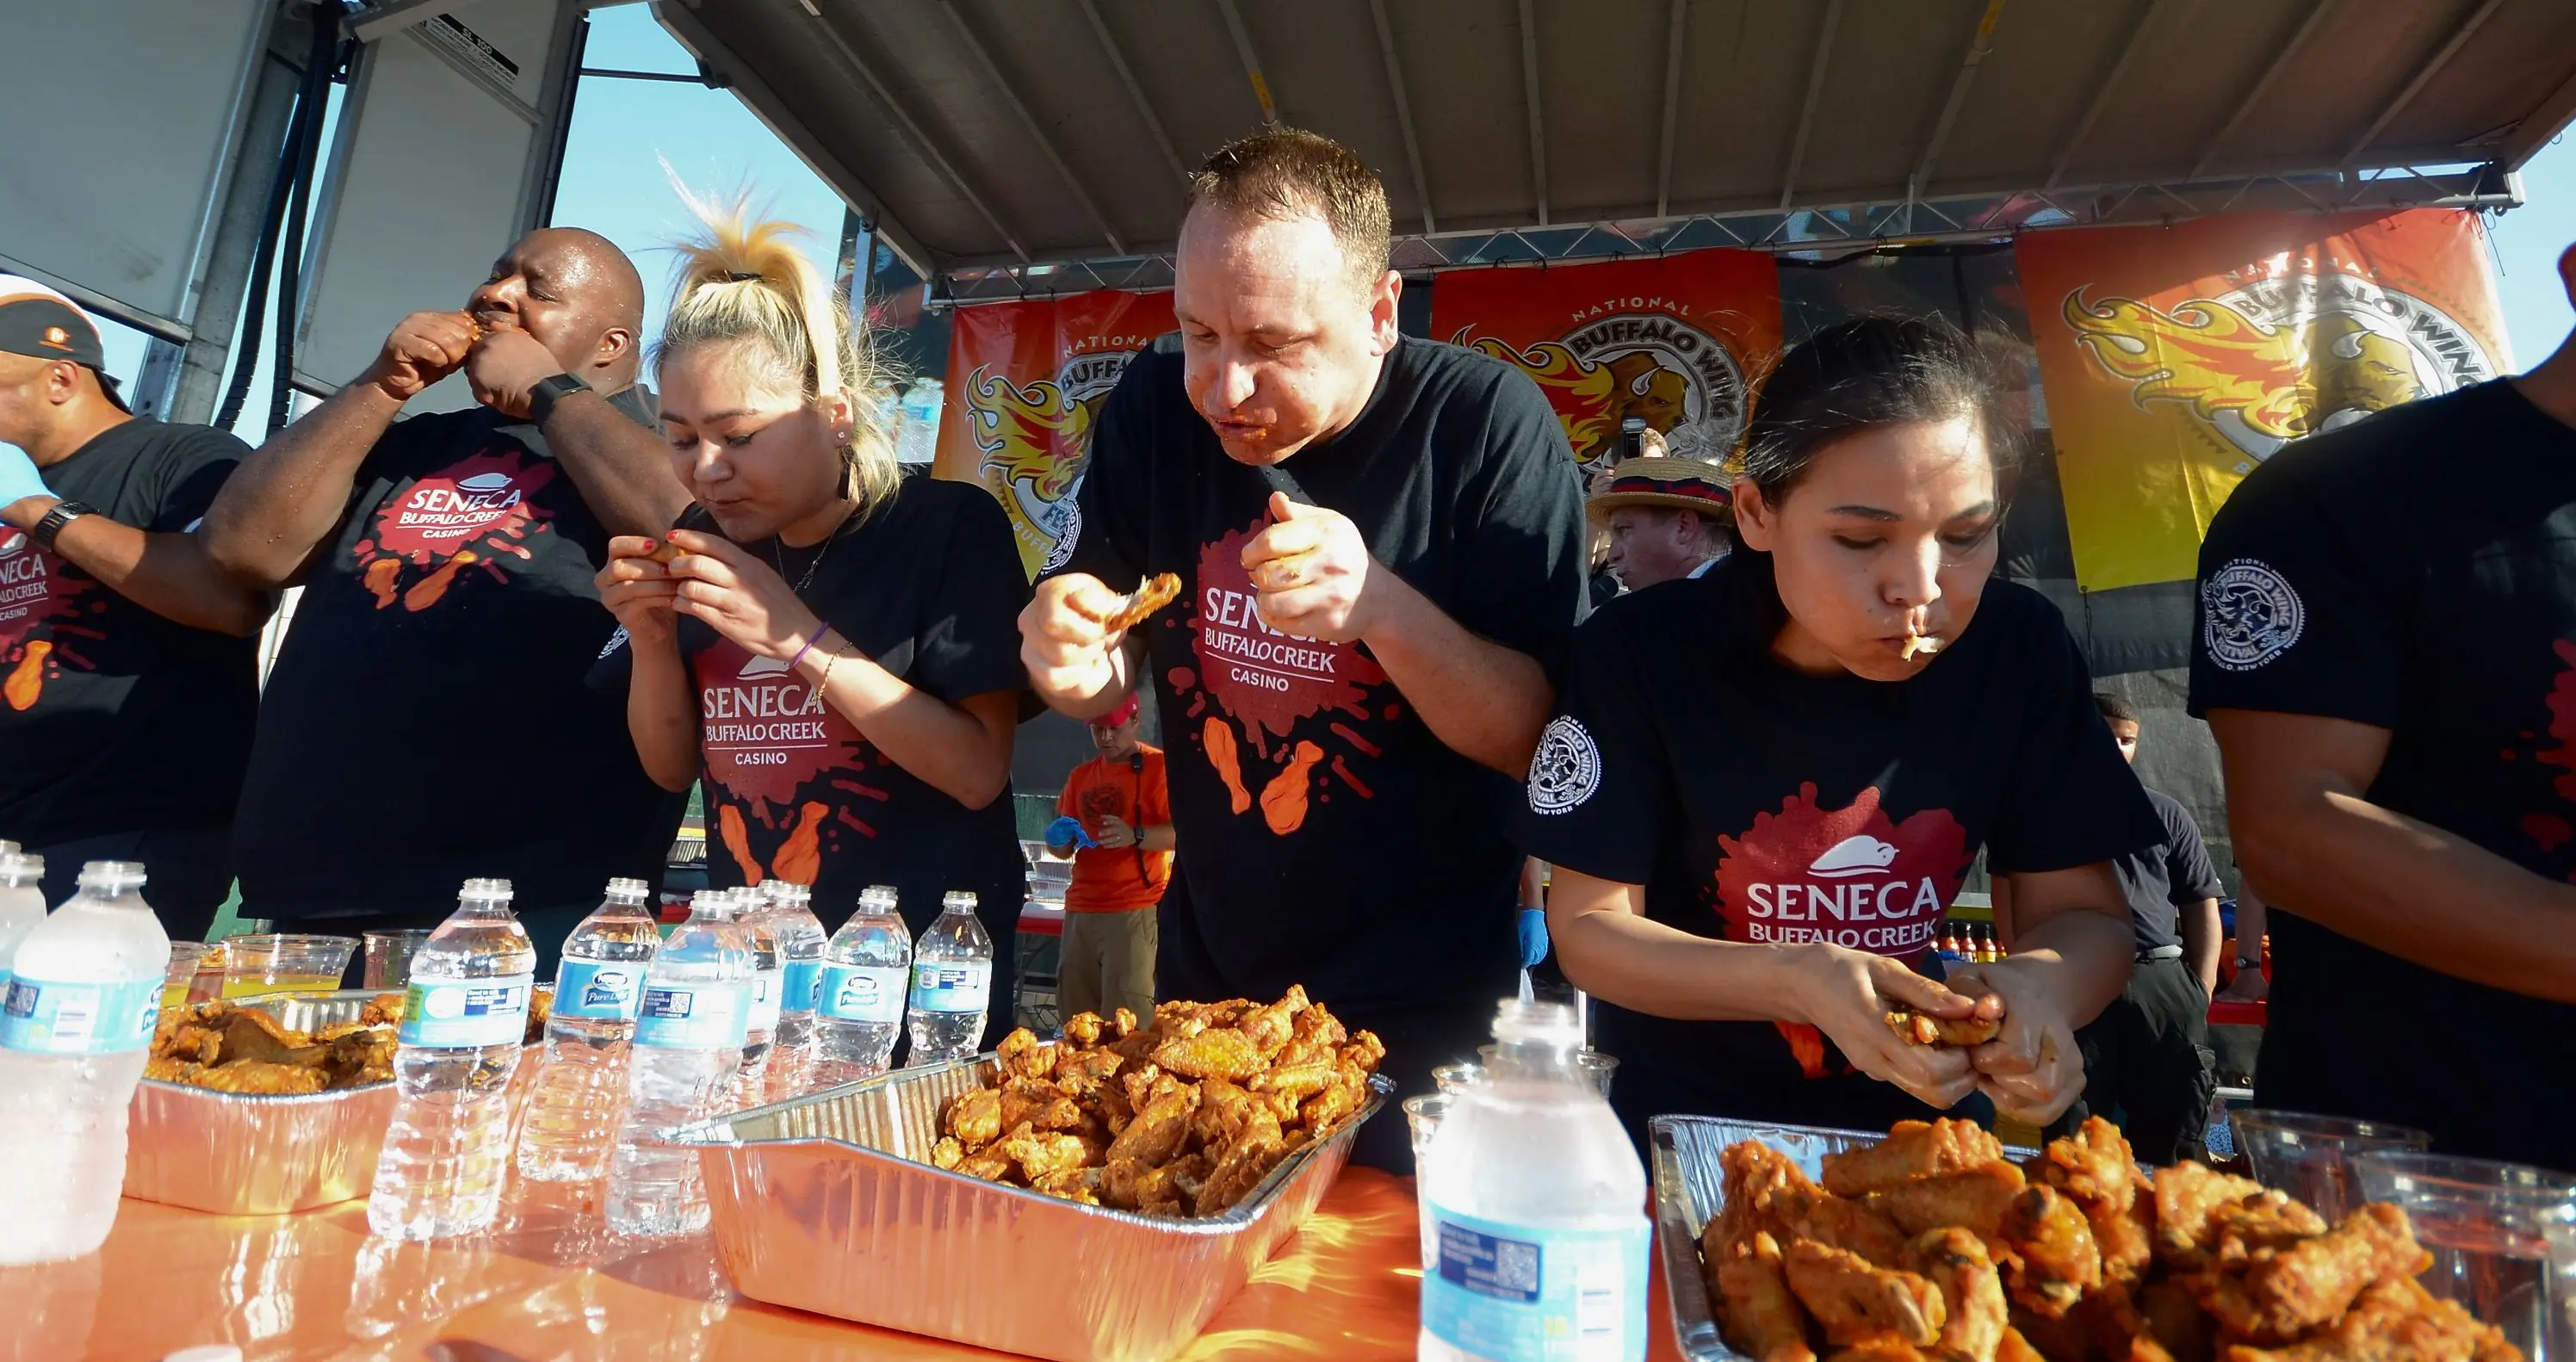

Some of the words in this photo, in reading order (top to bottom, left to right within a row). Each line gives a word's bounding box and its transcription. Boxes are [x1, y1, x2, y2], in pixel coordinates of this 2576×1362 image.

[461, 28, 474, 41] SL
[476, 38, 493, 54] 100
[1572, 296, 1690, 323] NATIONAL
[1063, 335, 1148, 358] NATIONA
[1574, 319, 1700, 358] BUFFALO
[1693, 344, 1738, 421] WING
[406, 489, 521, 512] SENECA
[399, 511, 463, 525] BUFFALO
[0, 554, 46, 585] NECA
[16, 581, 47, 599] CREEK
[1205, 627, 1272, 662] BUFFALO
[1273, 646, 1336, 673] CREEK
[2237, 662, 2257, 672] NEW
[1231, 667, 1290, 692] CASINO
[703, 684, 826, 719] SENECA
[706, 724, 766, 742] BUFFALO
[768, 721, 827, 740] CREEK
[735, 752, 787, 765] CASINO
[1534, 806, 1550, 815] NEW
[1747, 876, 1940, 921] SENECA
[1749, 922, 1860, 948] BUFFALO
[1863, 918, 1937, 948] CREEK
[588, 991, 610, 1003] Pure
